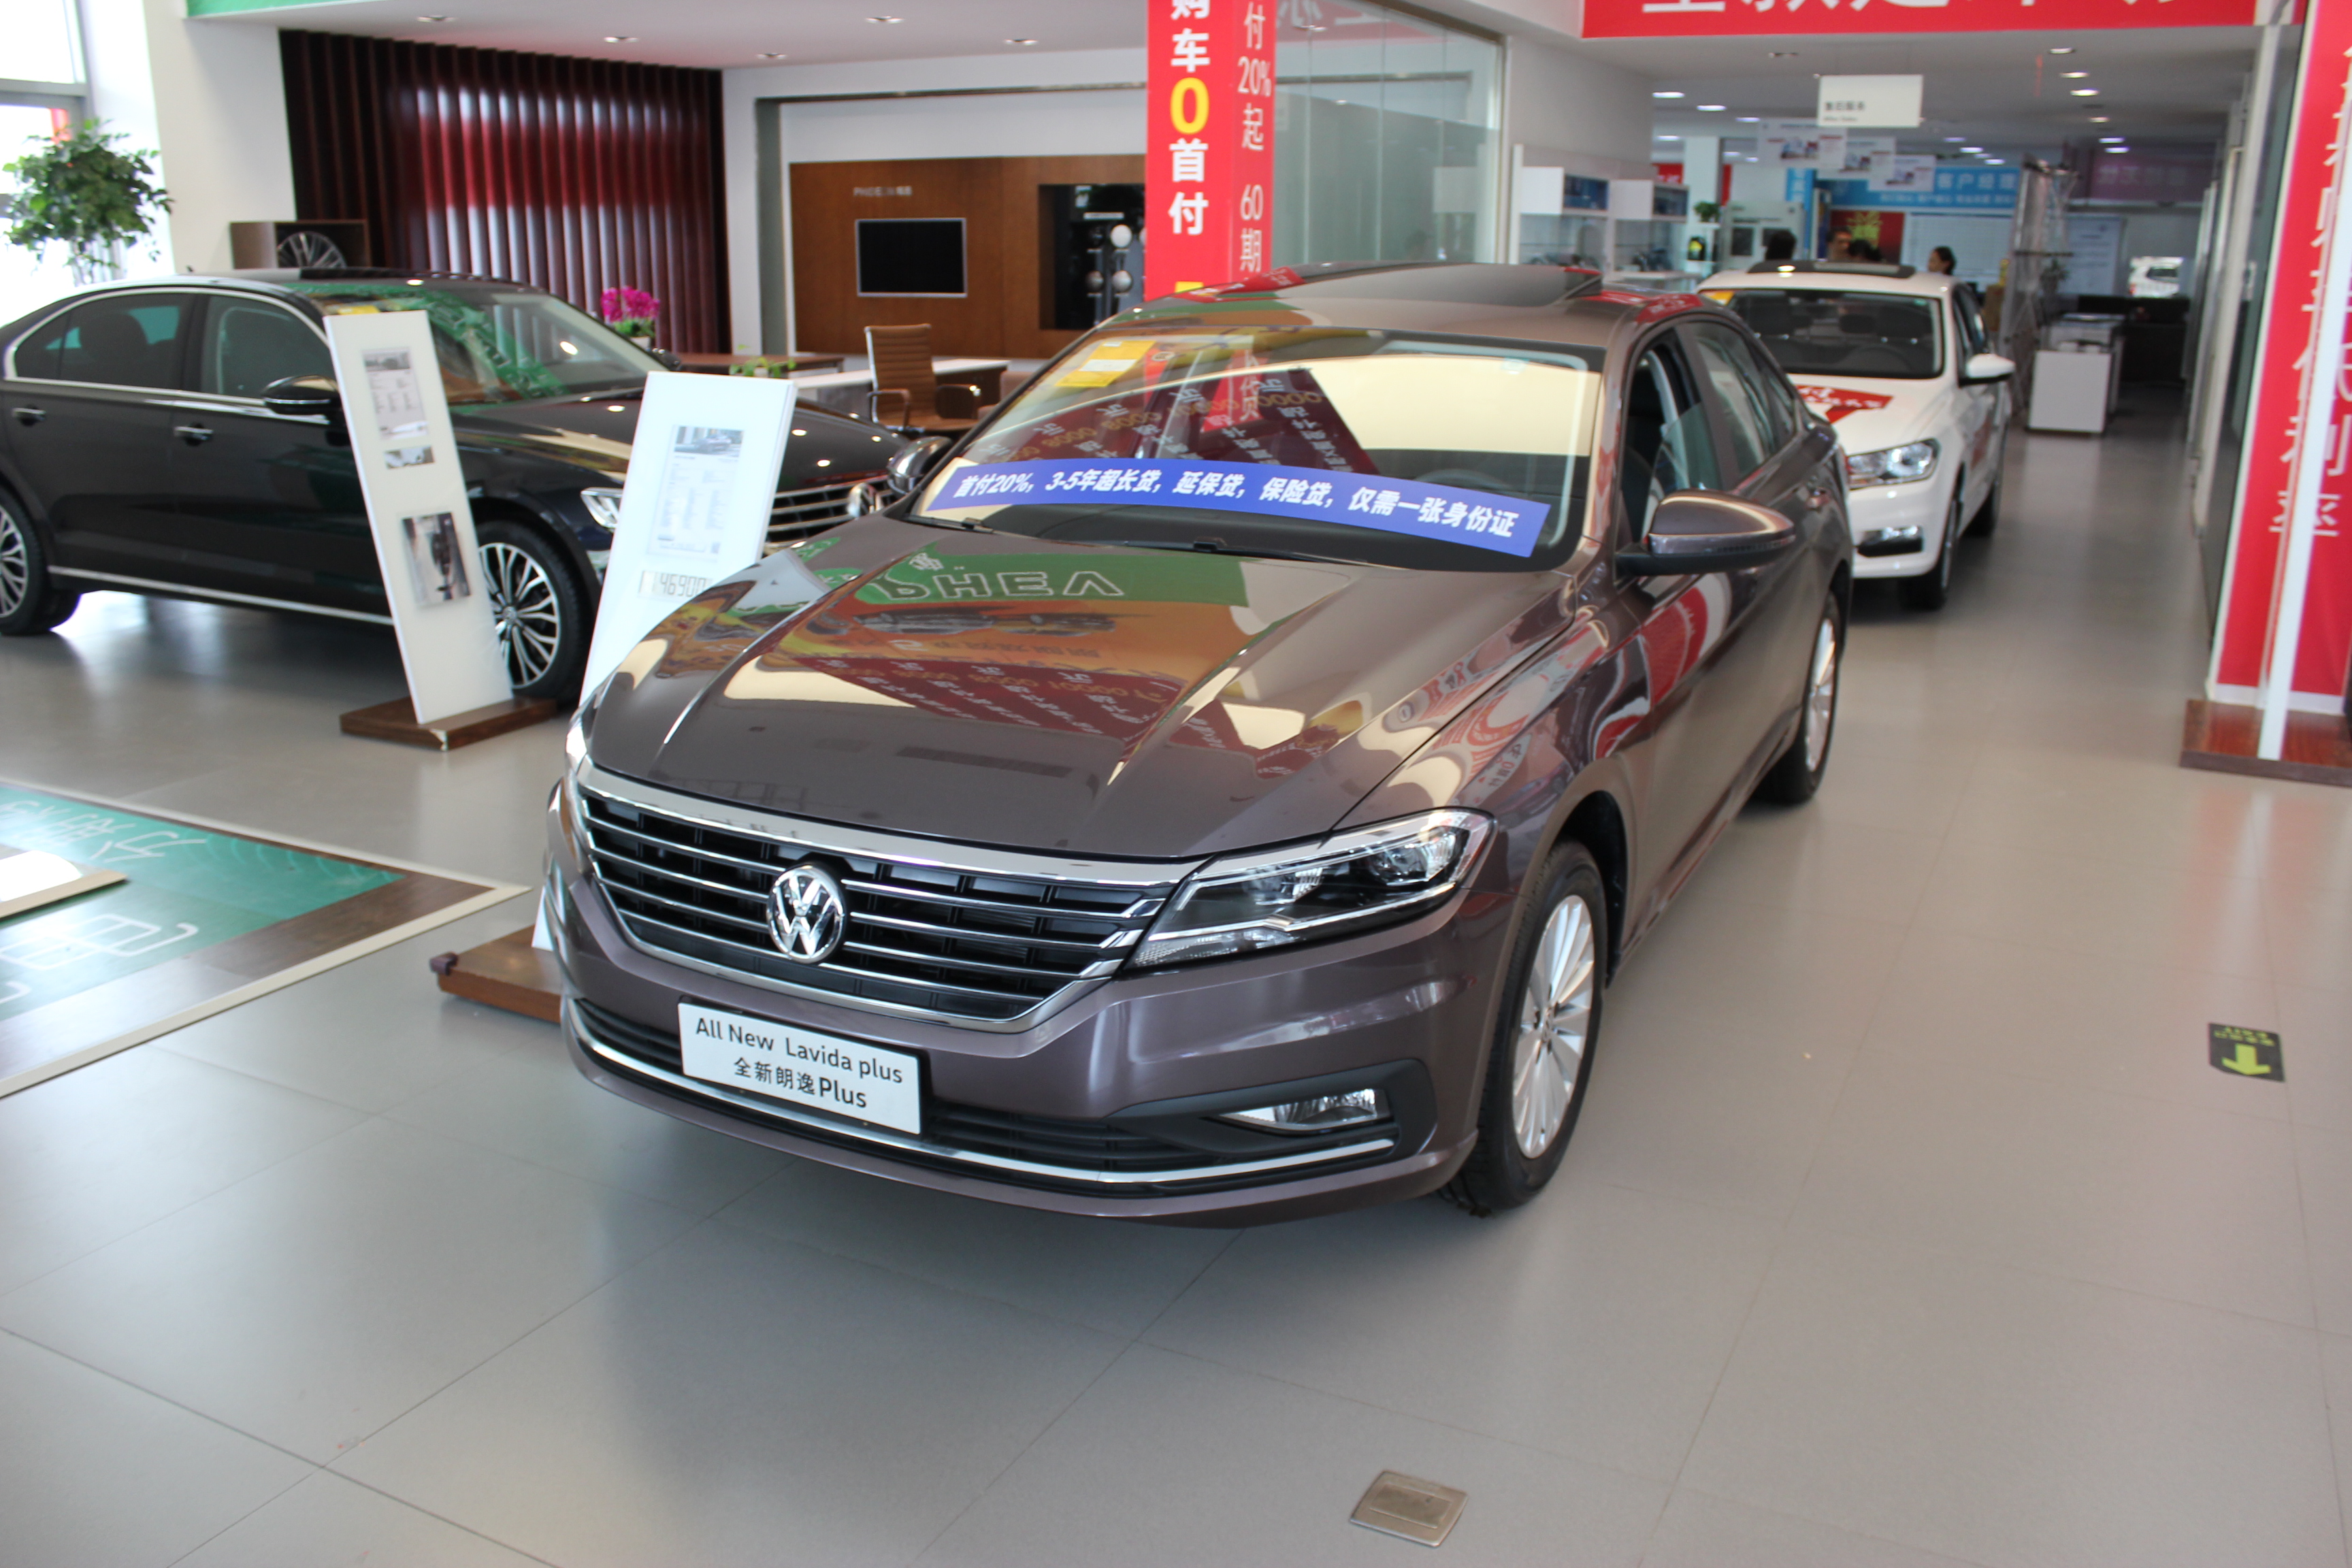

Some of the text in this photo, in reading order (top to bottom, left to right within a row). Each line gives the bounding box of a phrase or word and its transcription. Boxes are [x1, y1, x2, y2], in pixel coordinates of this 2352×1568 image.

[696, 1017, 903, 1083] All New Lavida plus
[733, 1056, 868, 1109] 全新朗逸Plus
